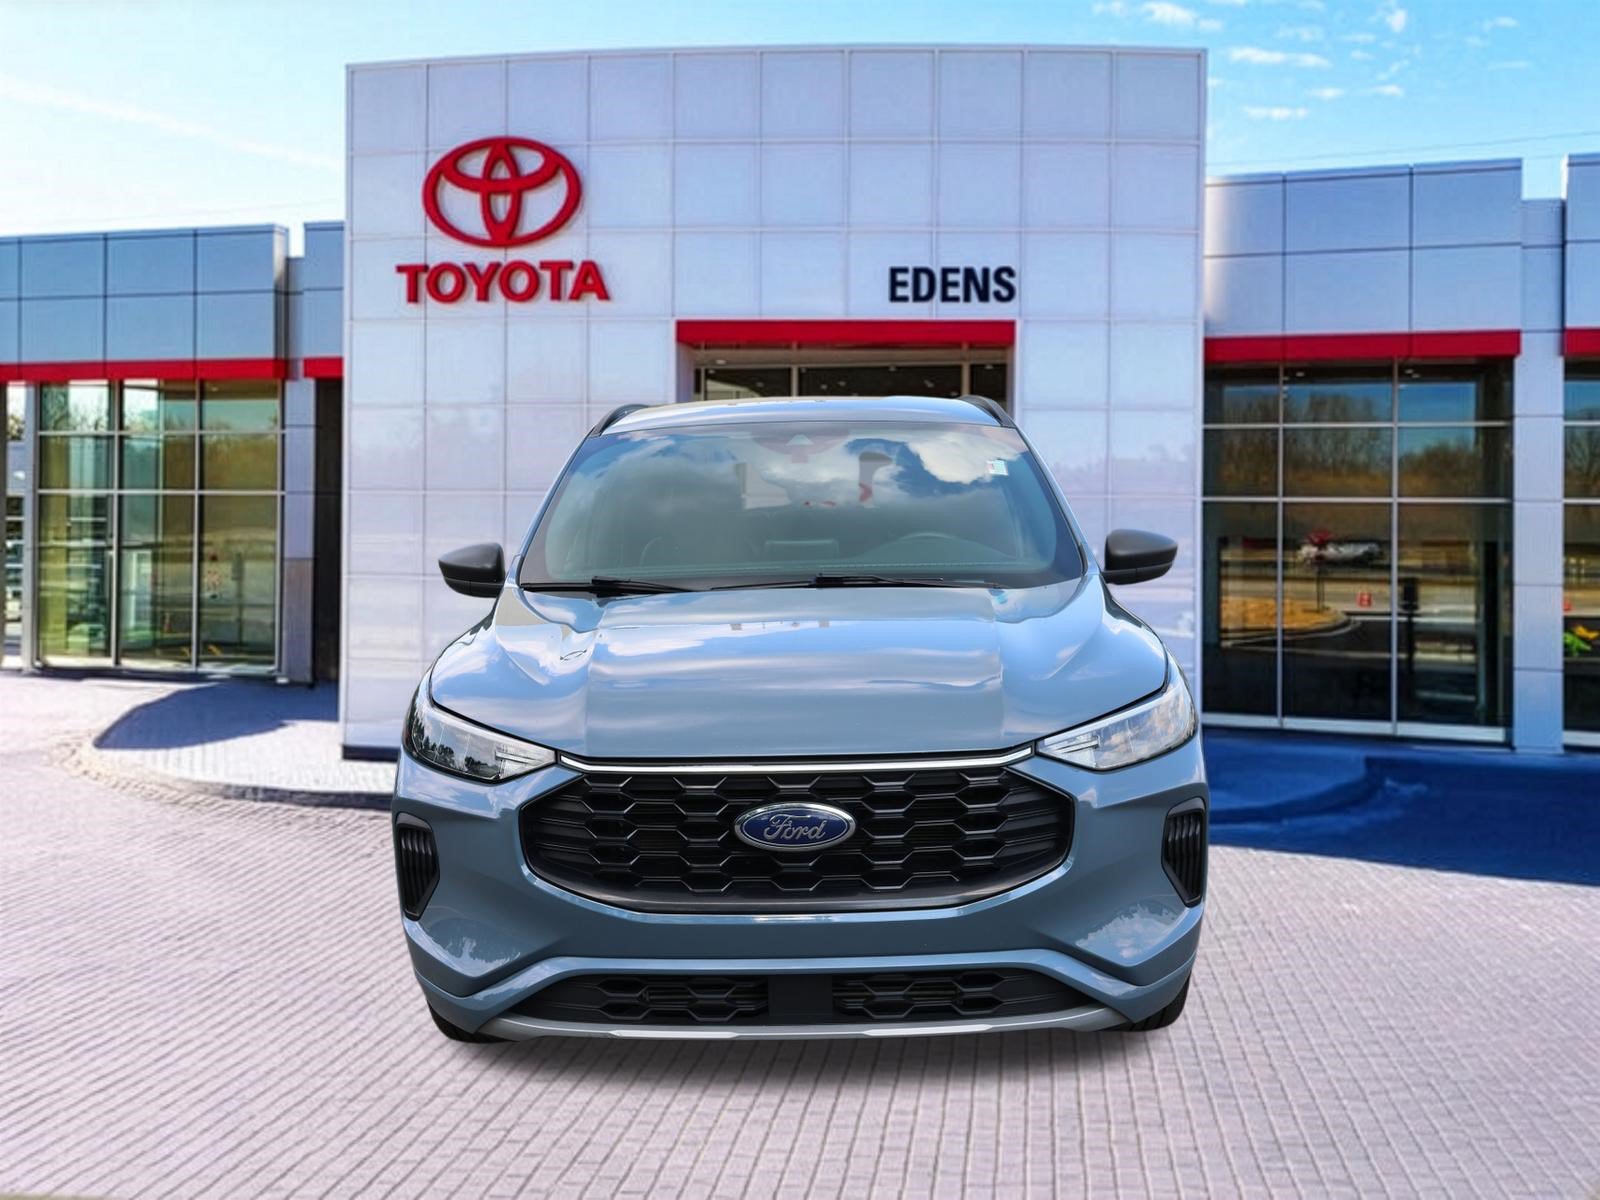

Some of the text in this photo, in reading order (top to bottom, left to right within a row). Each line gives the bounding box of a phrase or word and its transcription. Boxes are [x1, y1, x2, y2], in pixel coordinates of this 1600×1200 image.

[396, 260, 610, 304] TOYOTA
[889, 266, 1017, 303] EDENS
[763, 813, 828, 840] Ford
